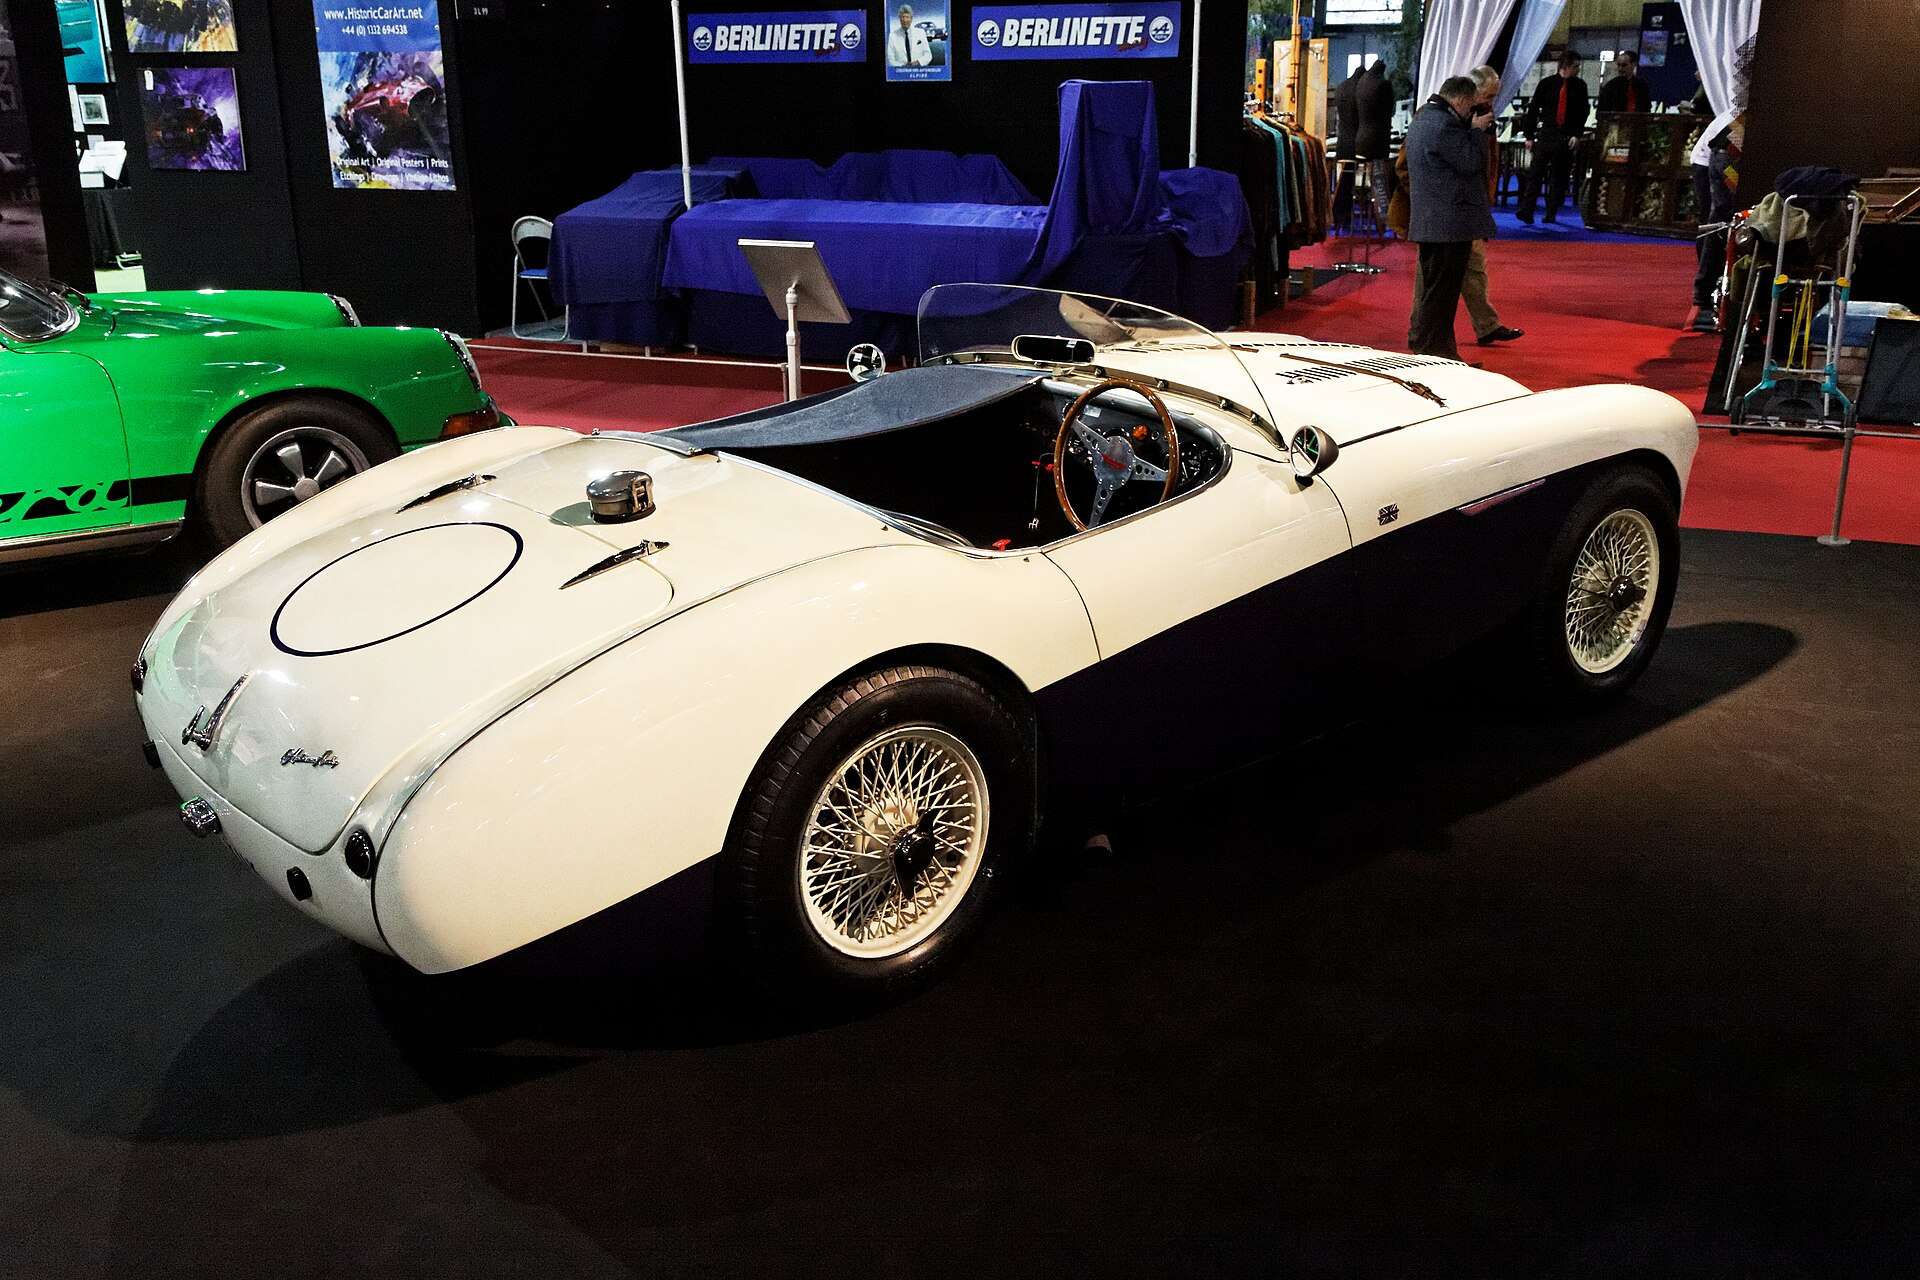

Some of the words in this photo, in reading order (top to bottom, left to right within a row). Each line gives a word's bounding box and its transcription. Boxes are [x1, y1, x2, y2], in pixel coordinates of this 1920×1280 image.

[324, 6, 424, 21] www.HistoricCarArt.net
[341, 25, 355, 35] +44
[356, 25, 366, 36] (0)
[367, 25, 382, 35] 1332
[382, 25, 408, 35] 694538
[714, 23, 837, 51] BERLINETTE
[1002, 16, 1145, 47] BERLINETTE
[336, 157, 360, 168] Original
[361, 158, 370, 166] Art
[377, 157, 401, 169] Original
[401, 158, 425, 168] Posters
[431, 158, 449, 168] Prints
